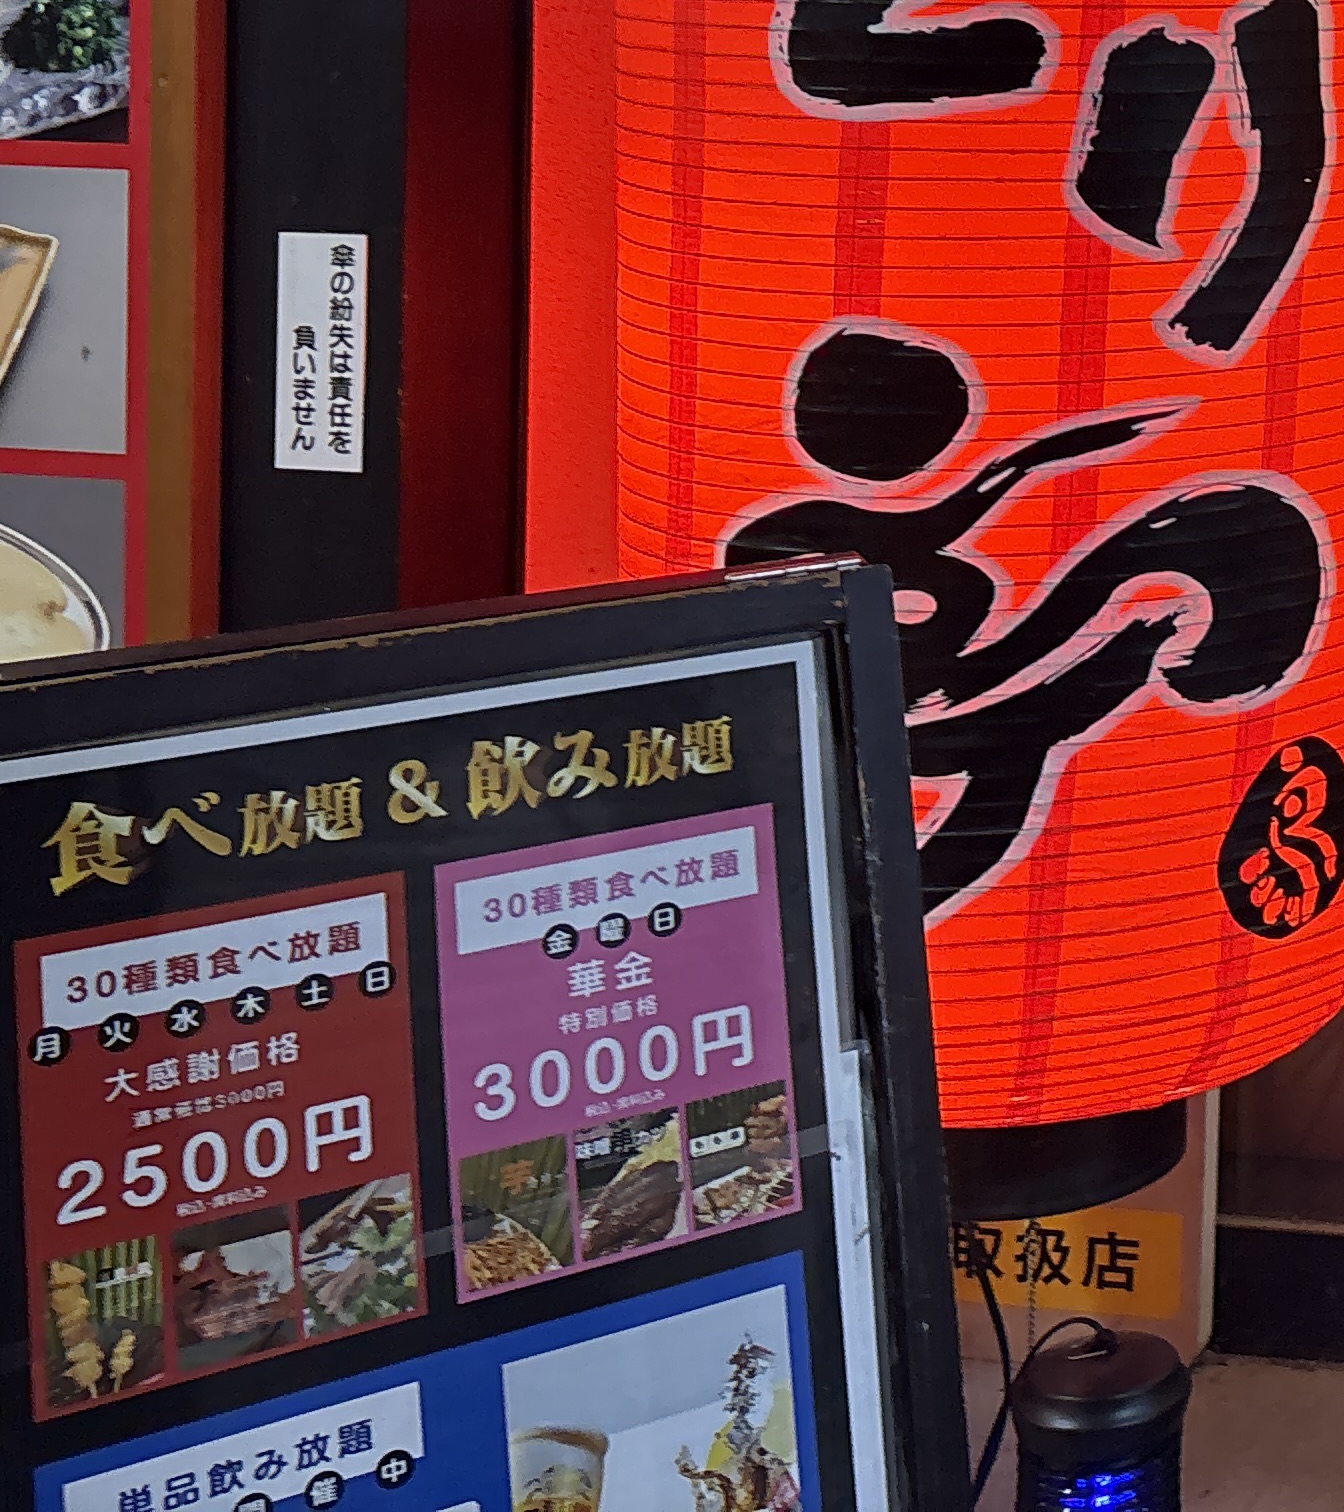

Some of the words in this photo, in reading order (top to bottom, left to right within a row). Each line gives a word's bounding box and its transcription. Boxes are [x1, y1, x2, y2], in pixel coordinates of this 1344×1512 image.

[289, 325, 317, 451] 負いません
[328, 243, 357, 455] 傘の紛失は責任を
[41, 776, 365, 896] 食べ放題
[388, 759, 447, 823] &
[465, 716, 734, 821] 飲み放題
[483, 849, 739, 923] 30種類食べ放題
[66, 921, 361, 1004] 30種類食べ放題
[567, 951, 654, 998] 華金
[473, 1004, 753, 1121] 3000円
[558, 995, 659, 1034] 特別価格
[104, 1032, 300, 1103] 大感謝価格
[56, 1095, 373, 1225] 2500円
